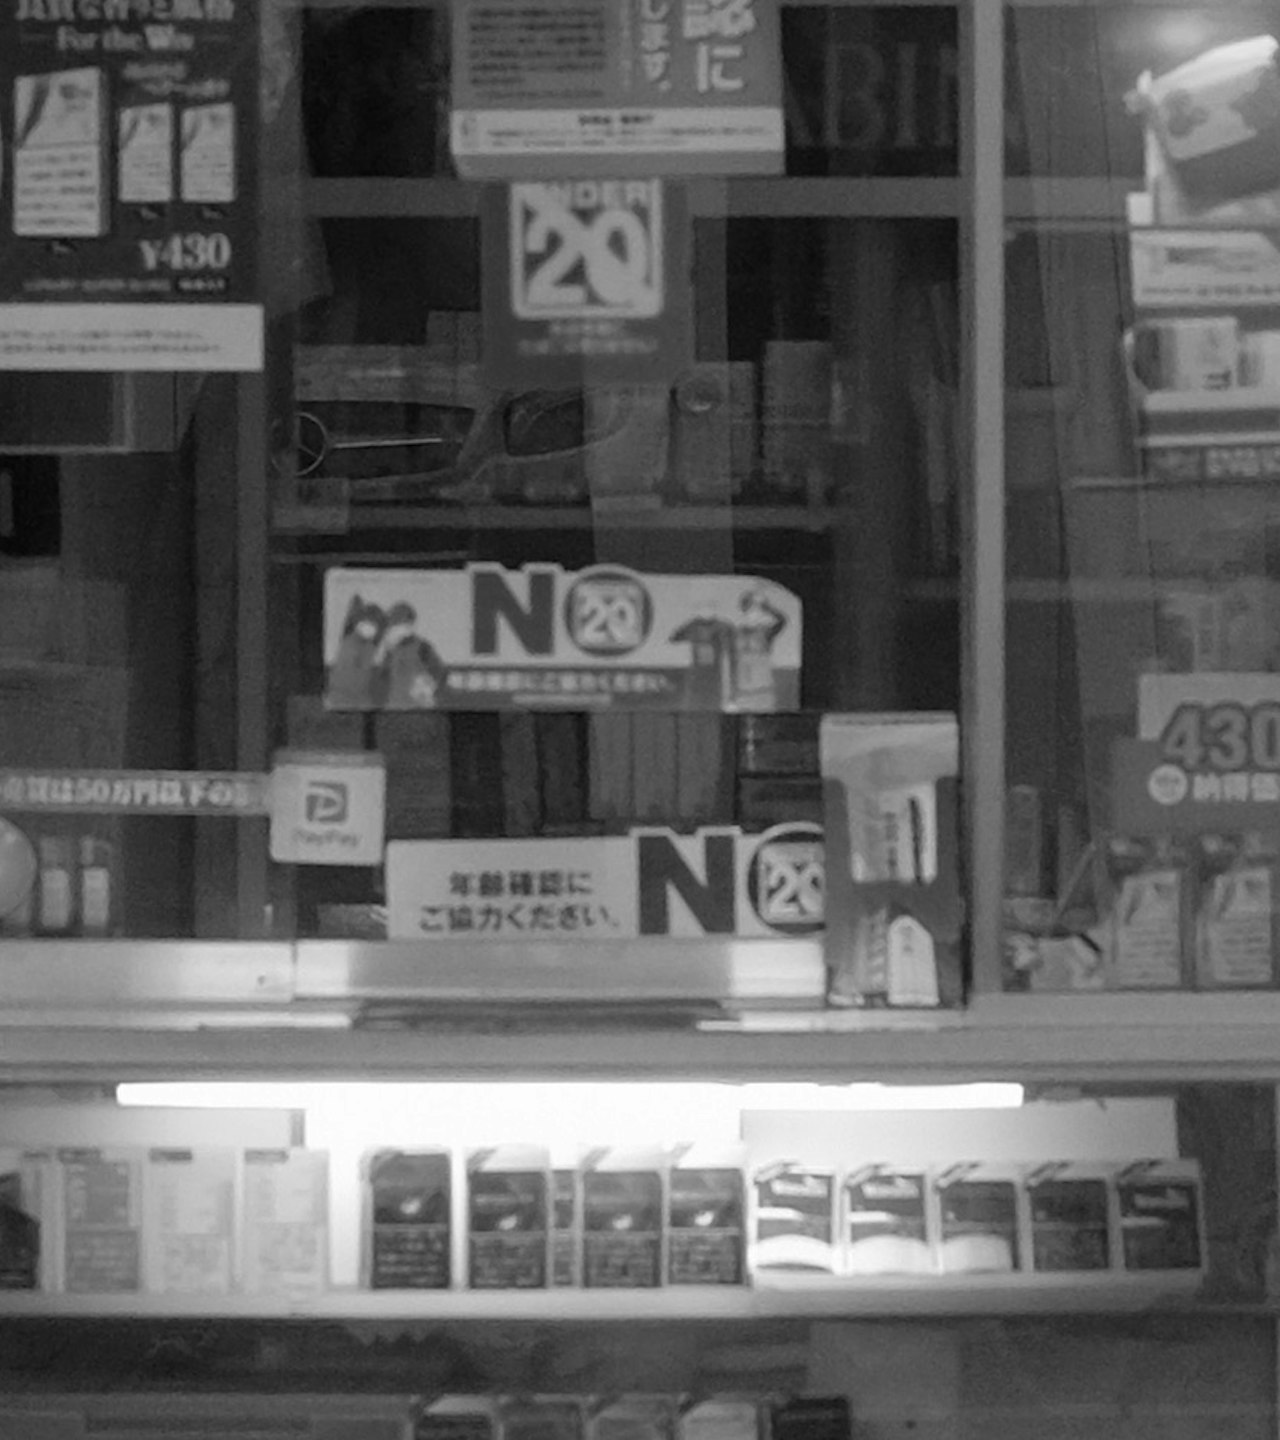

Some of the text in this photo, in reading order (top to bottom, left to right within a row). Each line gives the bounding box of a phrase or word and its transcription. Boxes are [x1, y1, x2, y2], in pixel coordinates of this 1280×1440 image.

[449, 869, 594, 898] 年齢確認に
[419, 904, 621, 933] ご協力ください。
